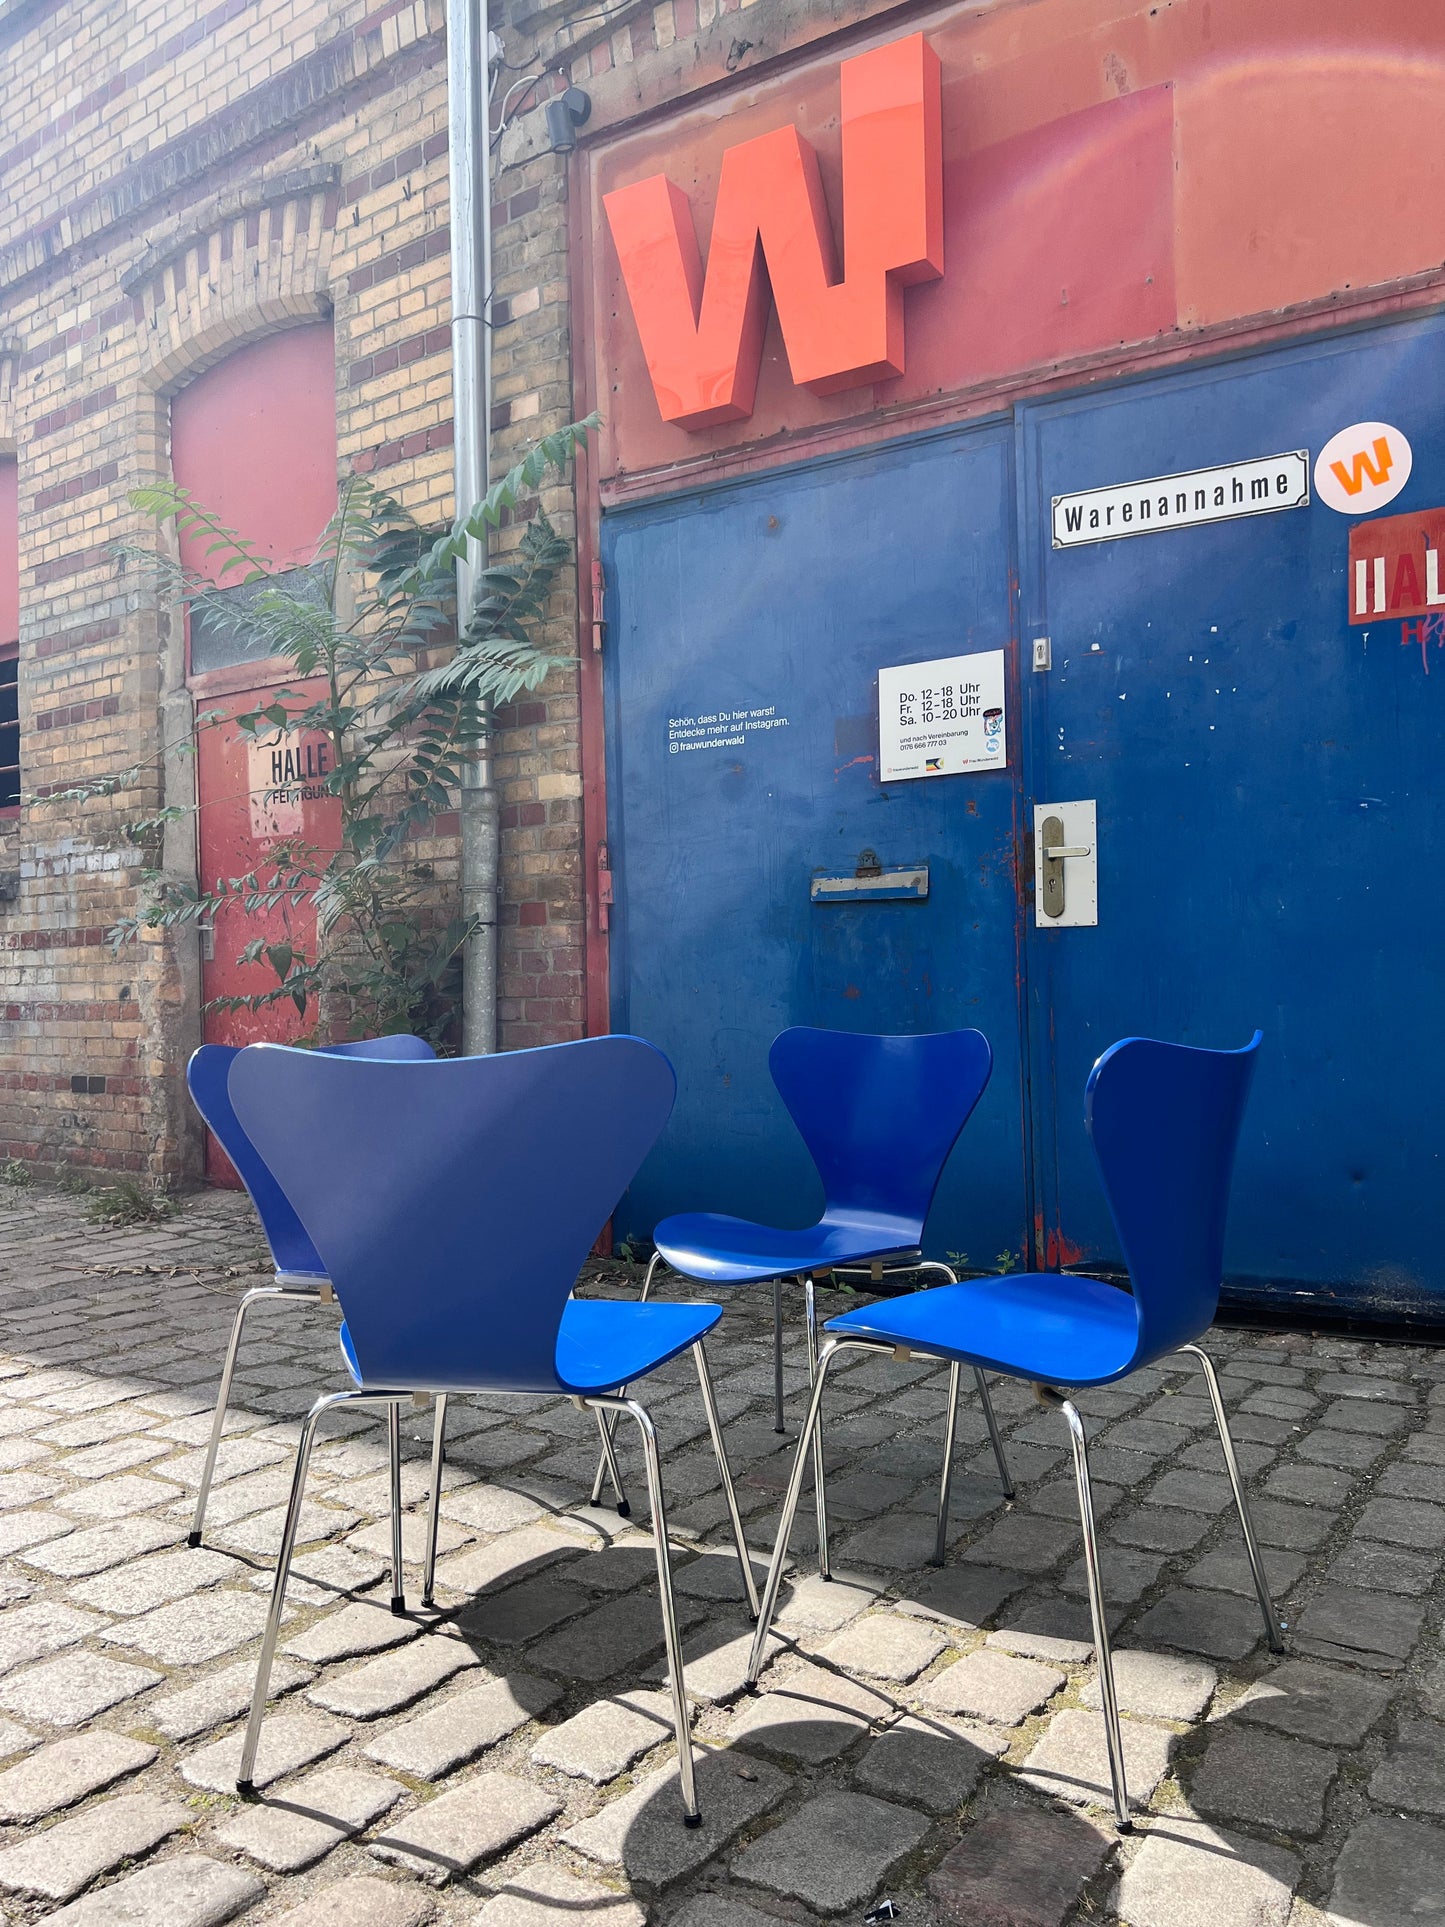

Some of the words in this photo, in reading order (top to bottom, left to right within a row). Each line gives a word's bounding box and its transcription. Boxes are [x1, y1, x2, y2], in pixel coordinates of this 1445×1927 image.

[602, 31, 943, 432] W
[1329, 436, 1394, 496] W
[1064, 473, 1288, 533] Warenannahme
[900, 693, 917, 703] Do.
[959, 683, 980, 694] Uhr
[900, 704, 912, 714] Fr.
[960, 695, 980, 706] Uhr
[669, 717, 696, 728] Schön,
[698, 715, 717, 725] dass
[719, 712, 730, 722] Du
[732, 710, 748, 719] hier
[749, 706, 775, 718] warst!
[899, 715, 917, 726] Sa.
[960, 706, 981, 718] Uhr
[669, 728, 705, 740] Entdecke
[707, 724, 729, 735] mehr
[730, 723, 743, 732] auf
[745, 717, 790, 731] Instagram.
[899, 736, 911, 744] und
[912, 734, 927, 742] nach
[927, 730, 969, 740] Vereinbarung
[680, 735, 745, 752] frauwunderwald
[272, 742, 329, 783] HALLE
